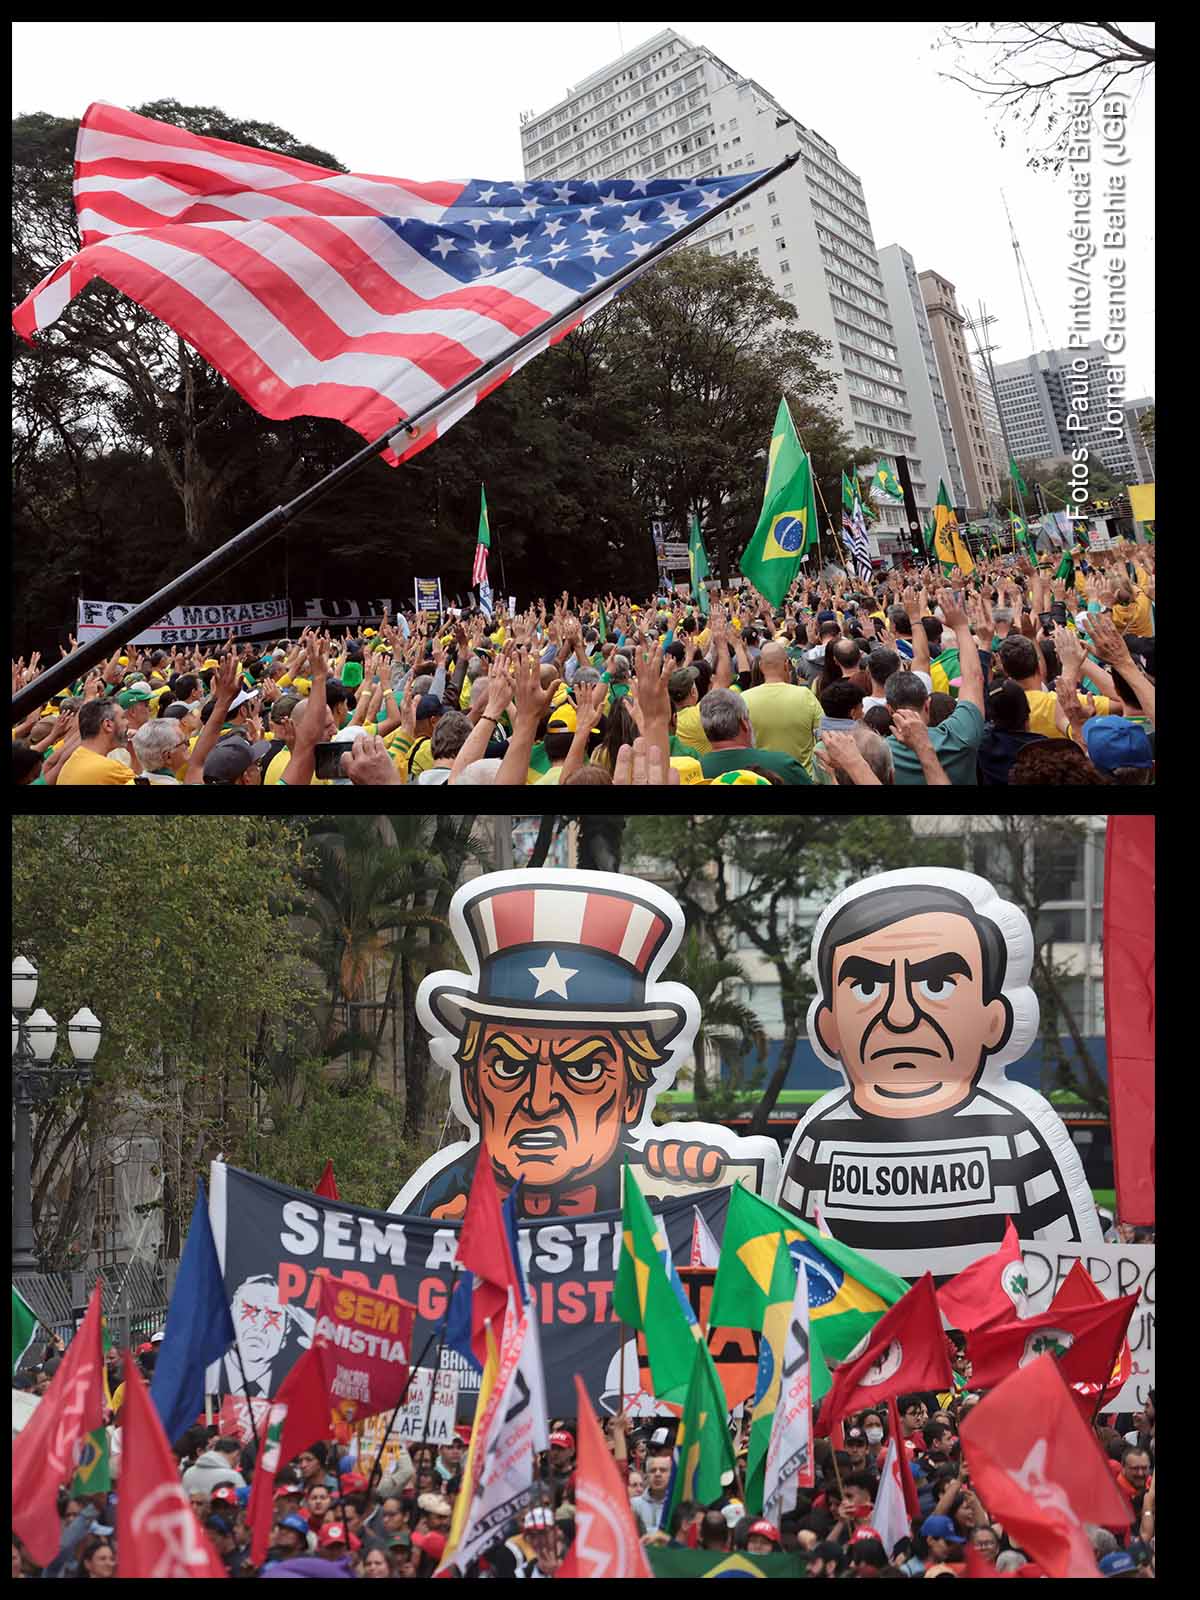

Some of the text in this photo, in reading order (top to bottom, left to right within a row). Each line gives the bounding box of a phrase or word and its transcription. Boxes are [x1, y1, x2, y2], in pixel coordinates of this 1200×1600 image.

[831, 1160, 985, 1197] BOLSONARO
[280, 1200, 407, 1267] SEM
[335, 1289, 400, 1335] SEM
